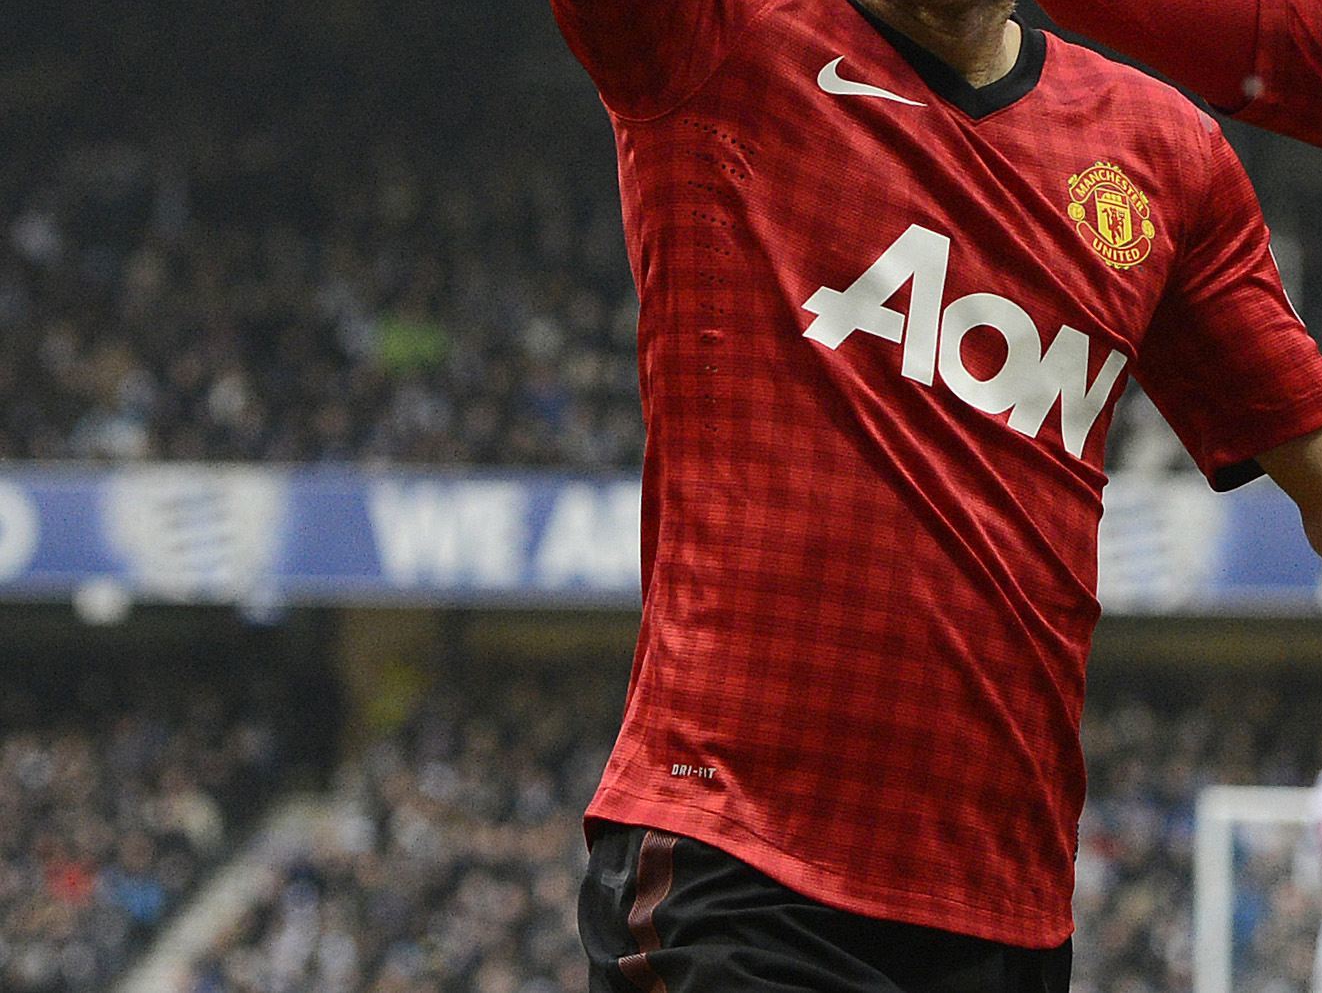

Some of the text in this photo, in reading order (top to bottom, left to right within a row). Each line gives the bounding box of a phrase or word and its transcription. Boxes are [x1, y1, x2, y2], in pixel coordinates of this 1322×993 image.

[1075, 169, 1145, 213] MANCHESTER
[1092, 238, 1140, 262] UNITED
[801, 223, 1128, 460] AON
[671, 763, 717, 779] DRI-FIT
